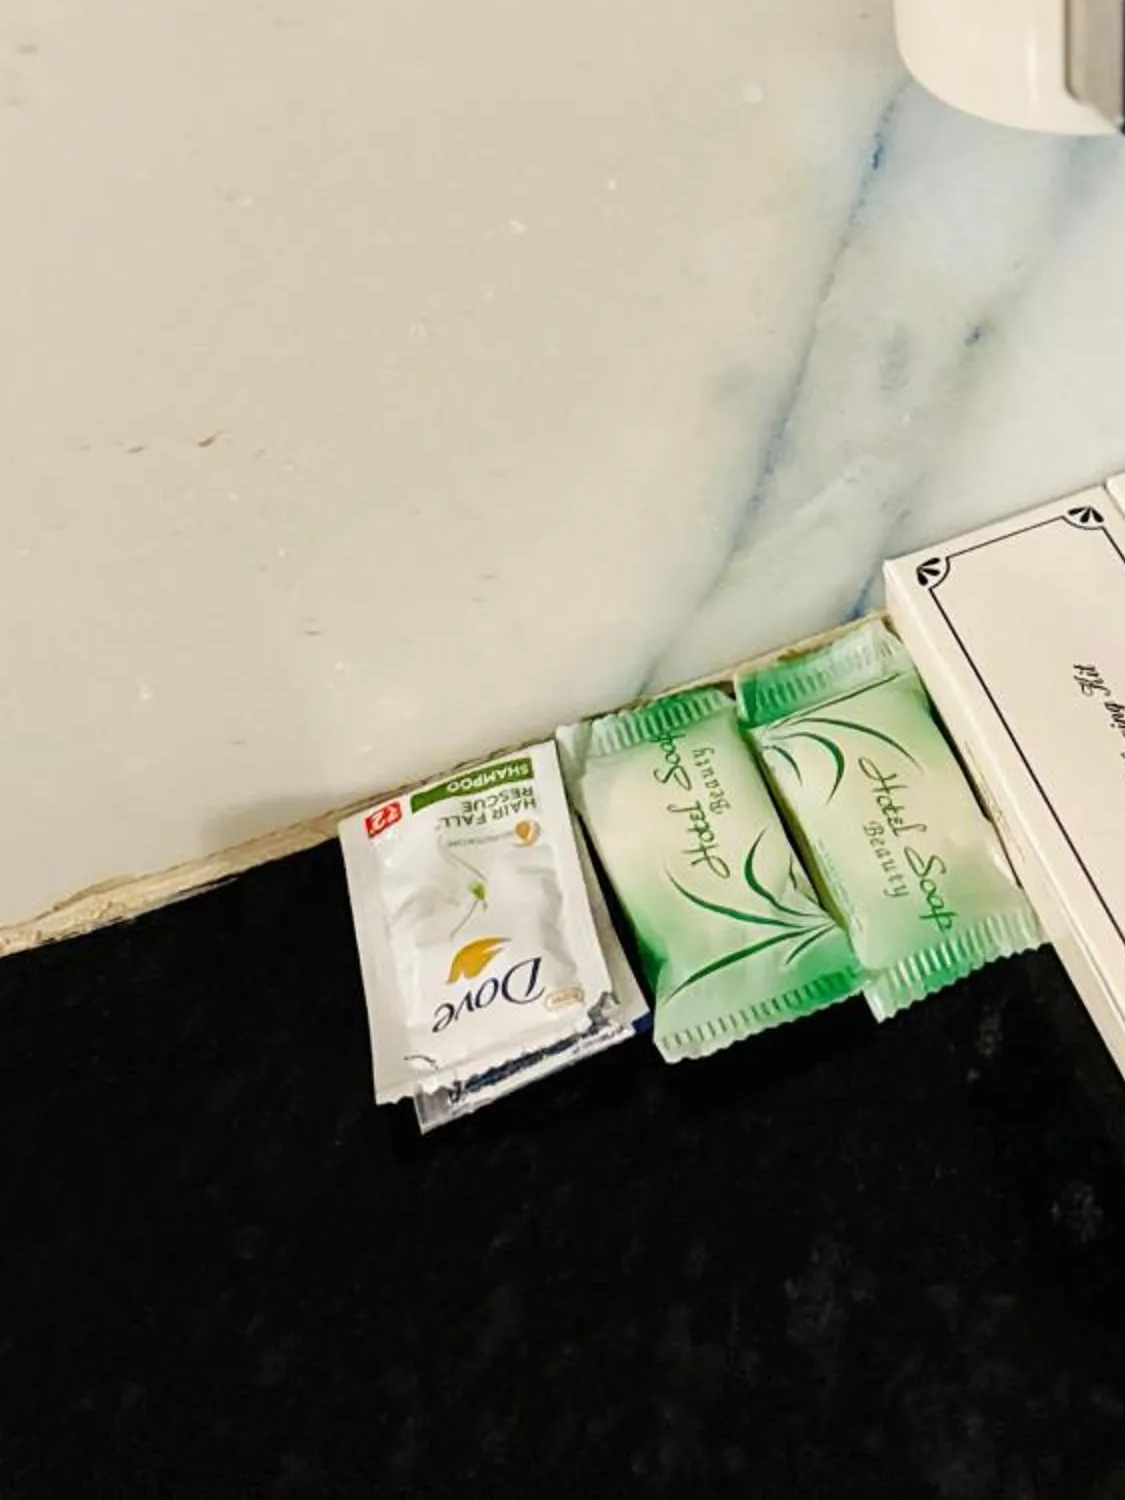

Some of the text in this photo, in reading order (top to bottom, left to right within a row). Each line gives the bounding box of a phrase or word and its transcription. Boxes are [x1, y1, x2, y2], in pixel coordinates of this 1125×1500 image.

[1073, 663, 1111, 697] Kit
[447, 762, 529, 794] SHAMPOO
[462, 785, 534, 813] RESCUE
[492, 797, 537, 822] HAIR
[691, 747, 732, 816] Beauty
[667, 800, 731, 880] Hotel
[858, 756, 957, 932] Hotel Soap
[863, 820, 910, 898] Beauty
[432, 957, 547, 1033] Dove
